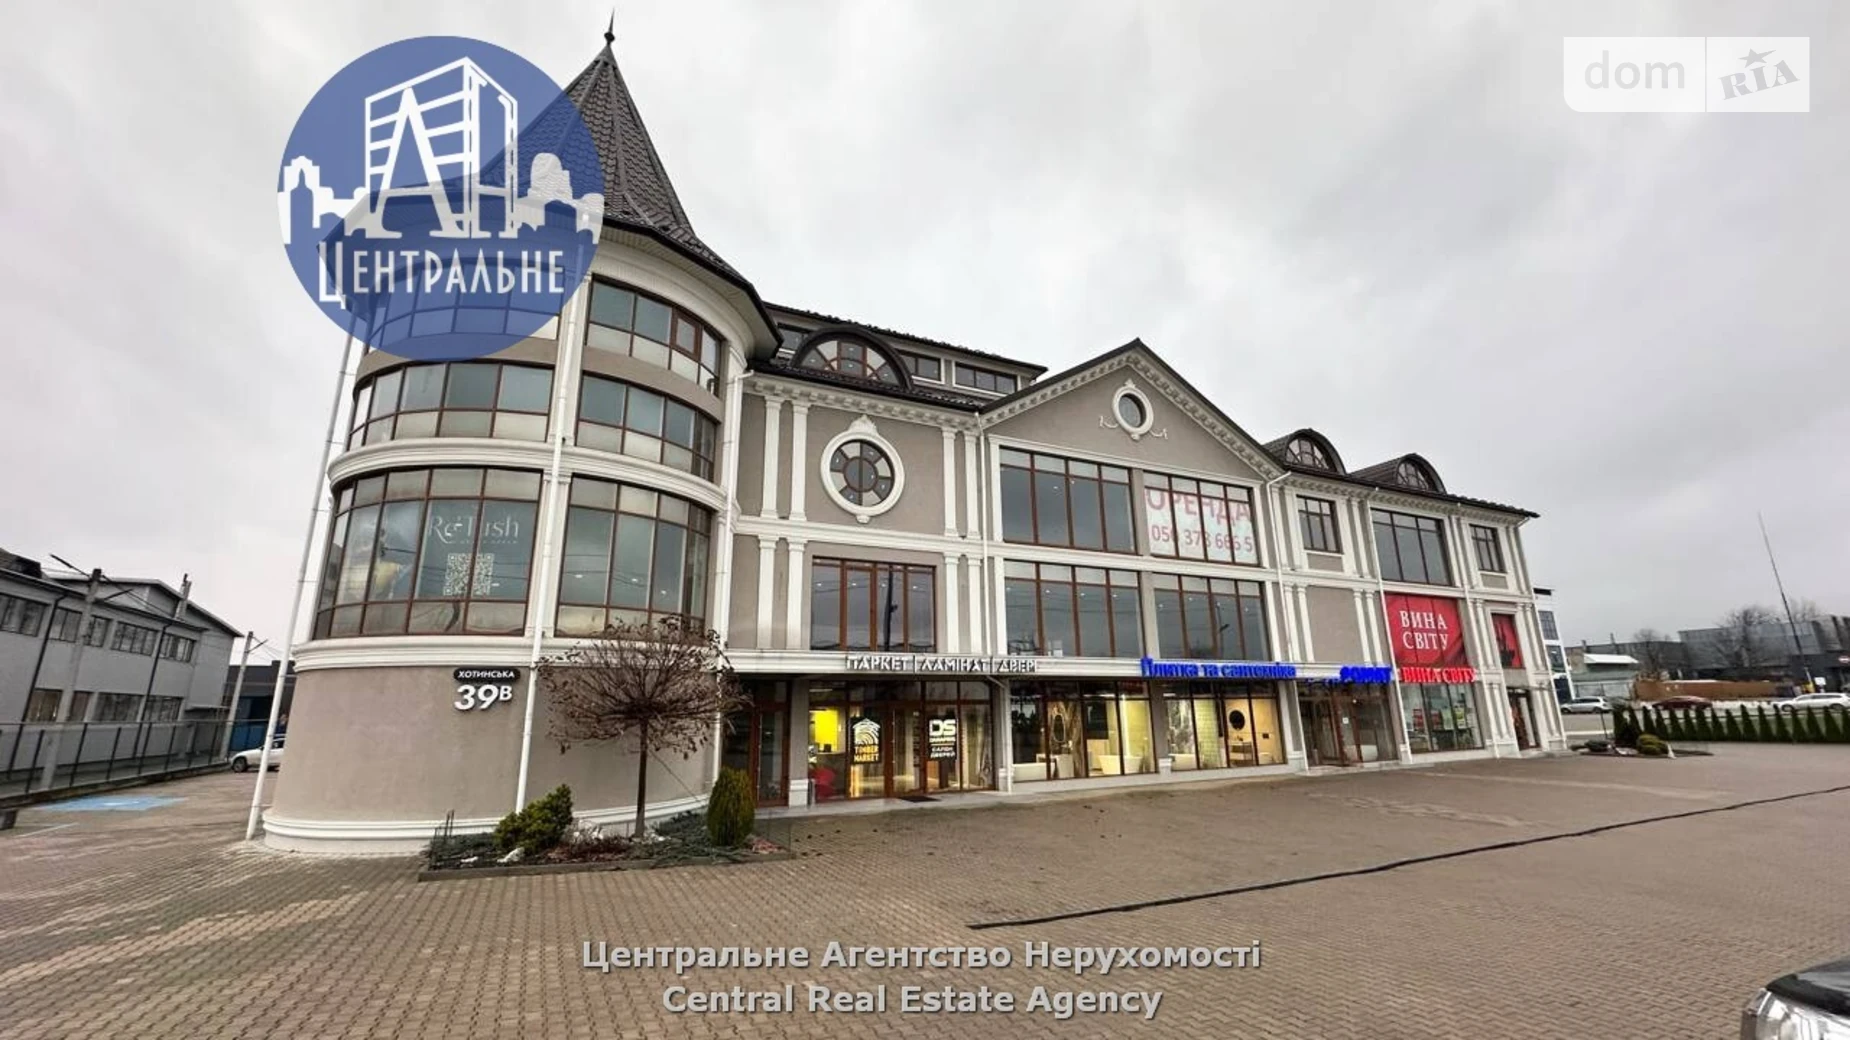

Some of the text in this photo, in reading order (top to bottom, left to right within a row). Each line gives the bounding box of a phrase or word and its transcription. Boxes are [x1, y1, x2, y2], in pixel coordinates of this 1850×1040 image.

[1151, 524, 1177, 543] 05
[1399, 611, 1448, 630] ВИНА
[1402, 631, 1448, 650] СВІТУ
[846, 655, 909, 671] ПАРКЕТ
[920, 657, 987, 672] ЛАМІНАТ
[1141, 657, 1198, 678] Плитка
[1201, 664, 1218, 678] та
[457, 670, 515, 679] ХОТИНСЬКА
[929, 719, 956, 736] DS
